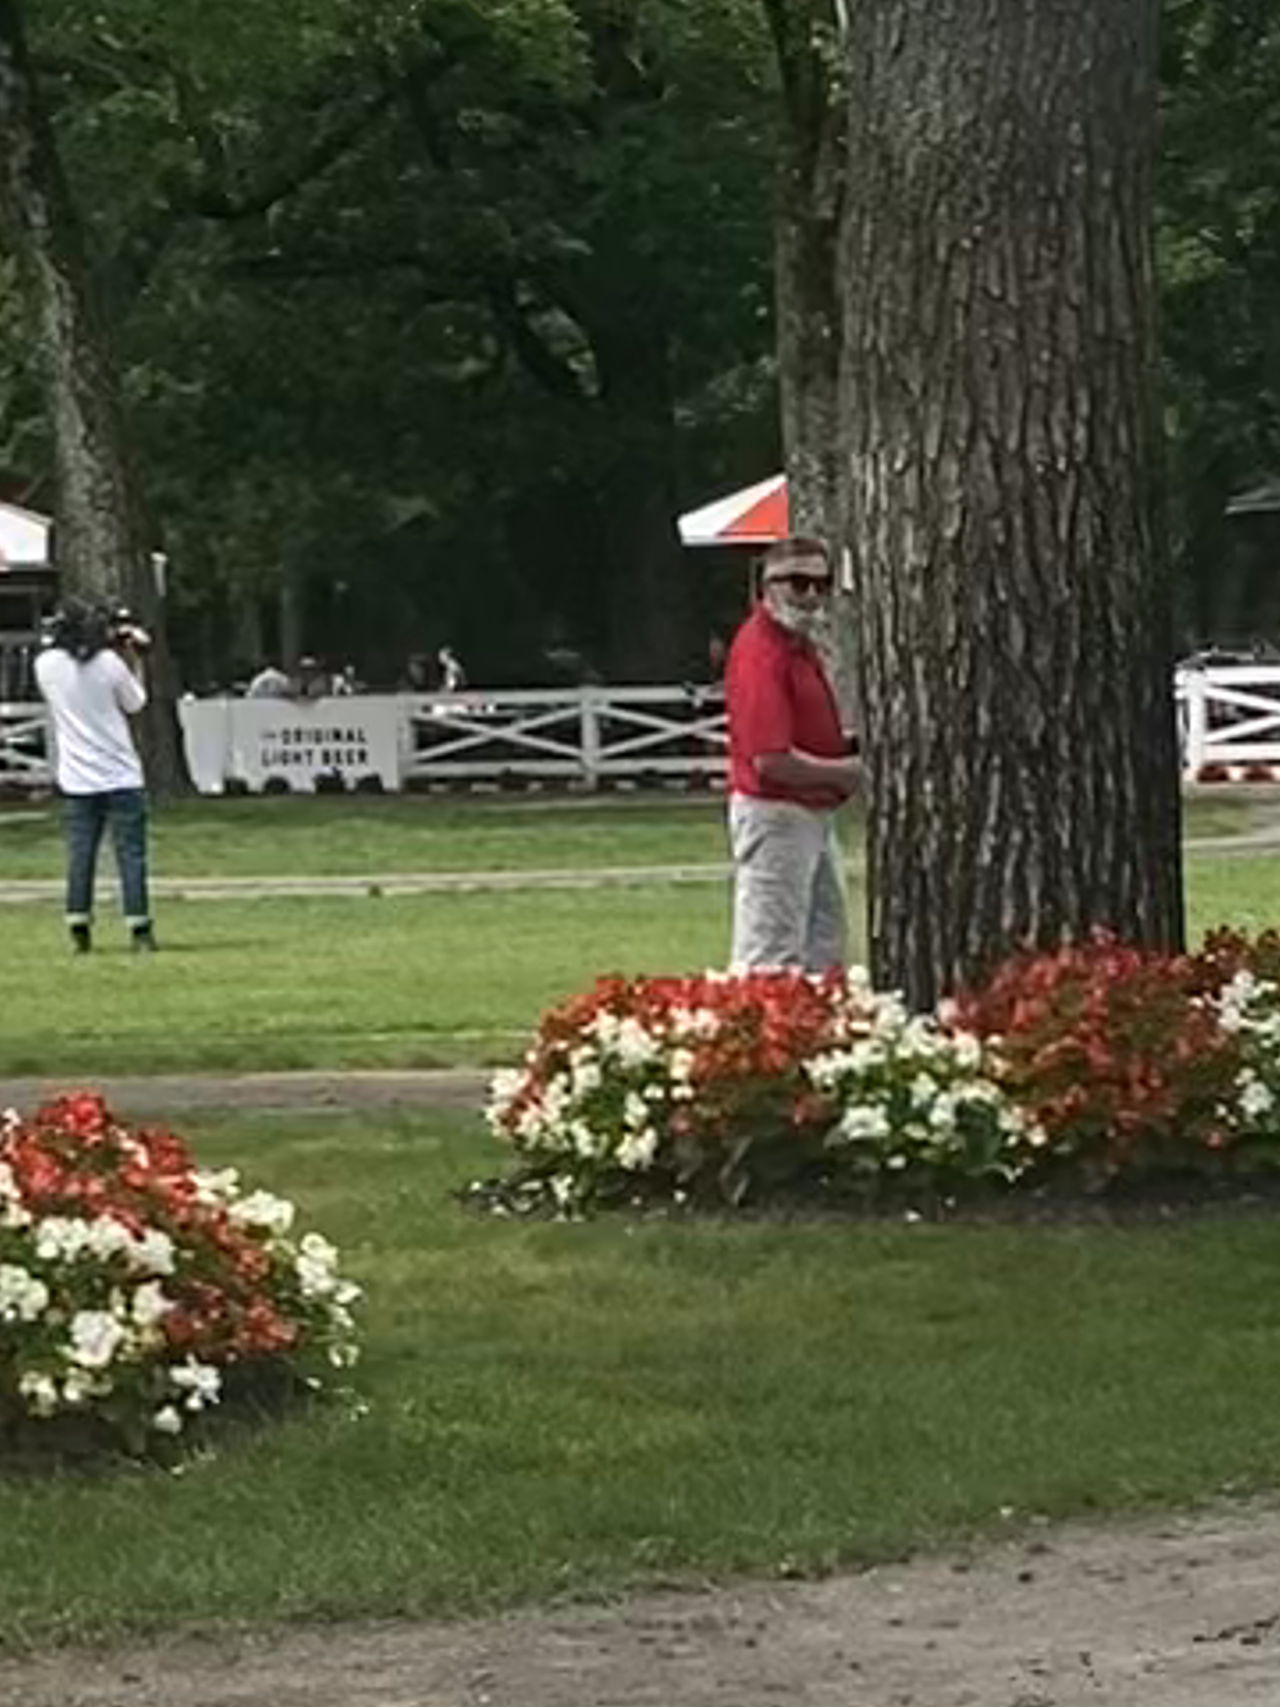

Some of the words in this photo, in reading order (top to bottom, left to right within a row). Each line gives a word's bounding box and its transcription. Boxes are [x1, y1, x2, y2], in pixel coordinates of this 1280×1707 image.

[281, 727, 367, 746] ORIGINAL
[261, 748, 312, 767] LIGHT
[322, 748, 368, 766] BEER
